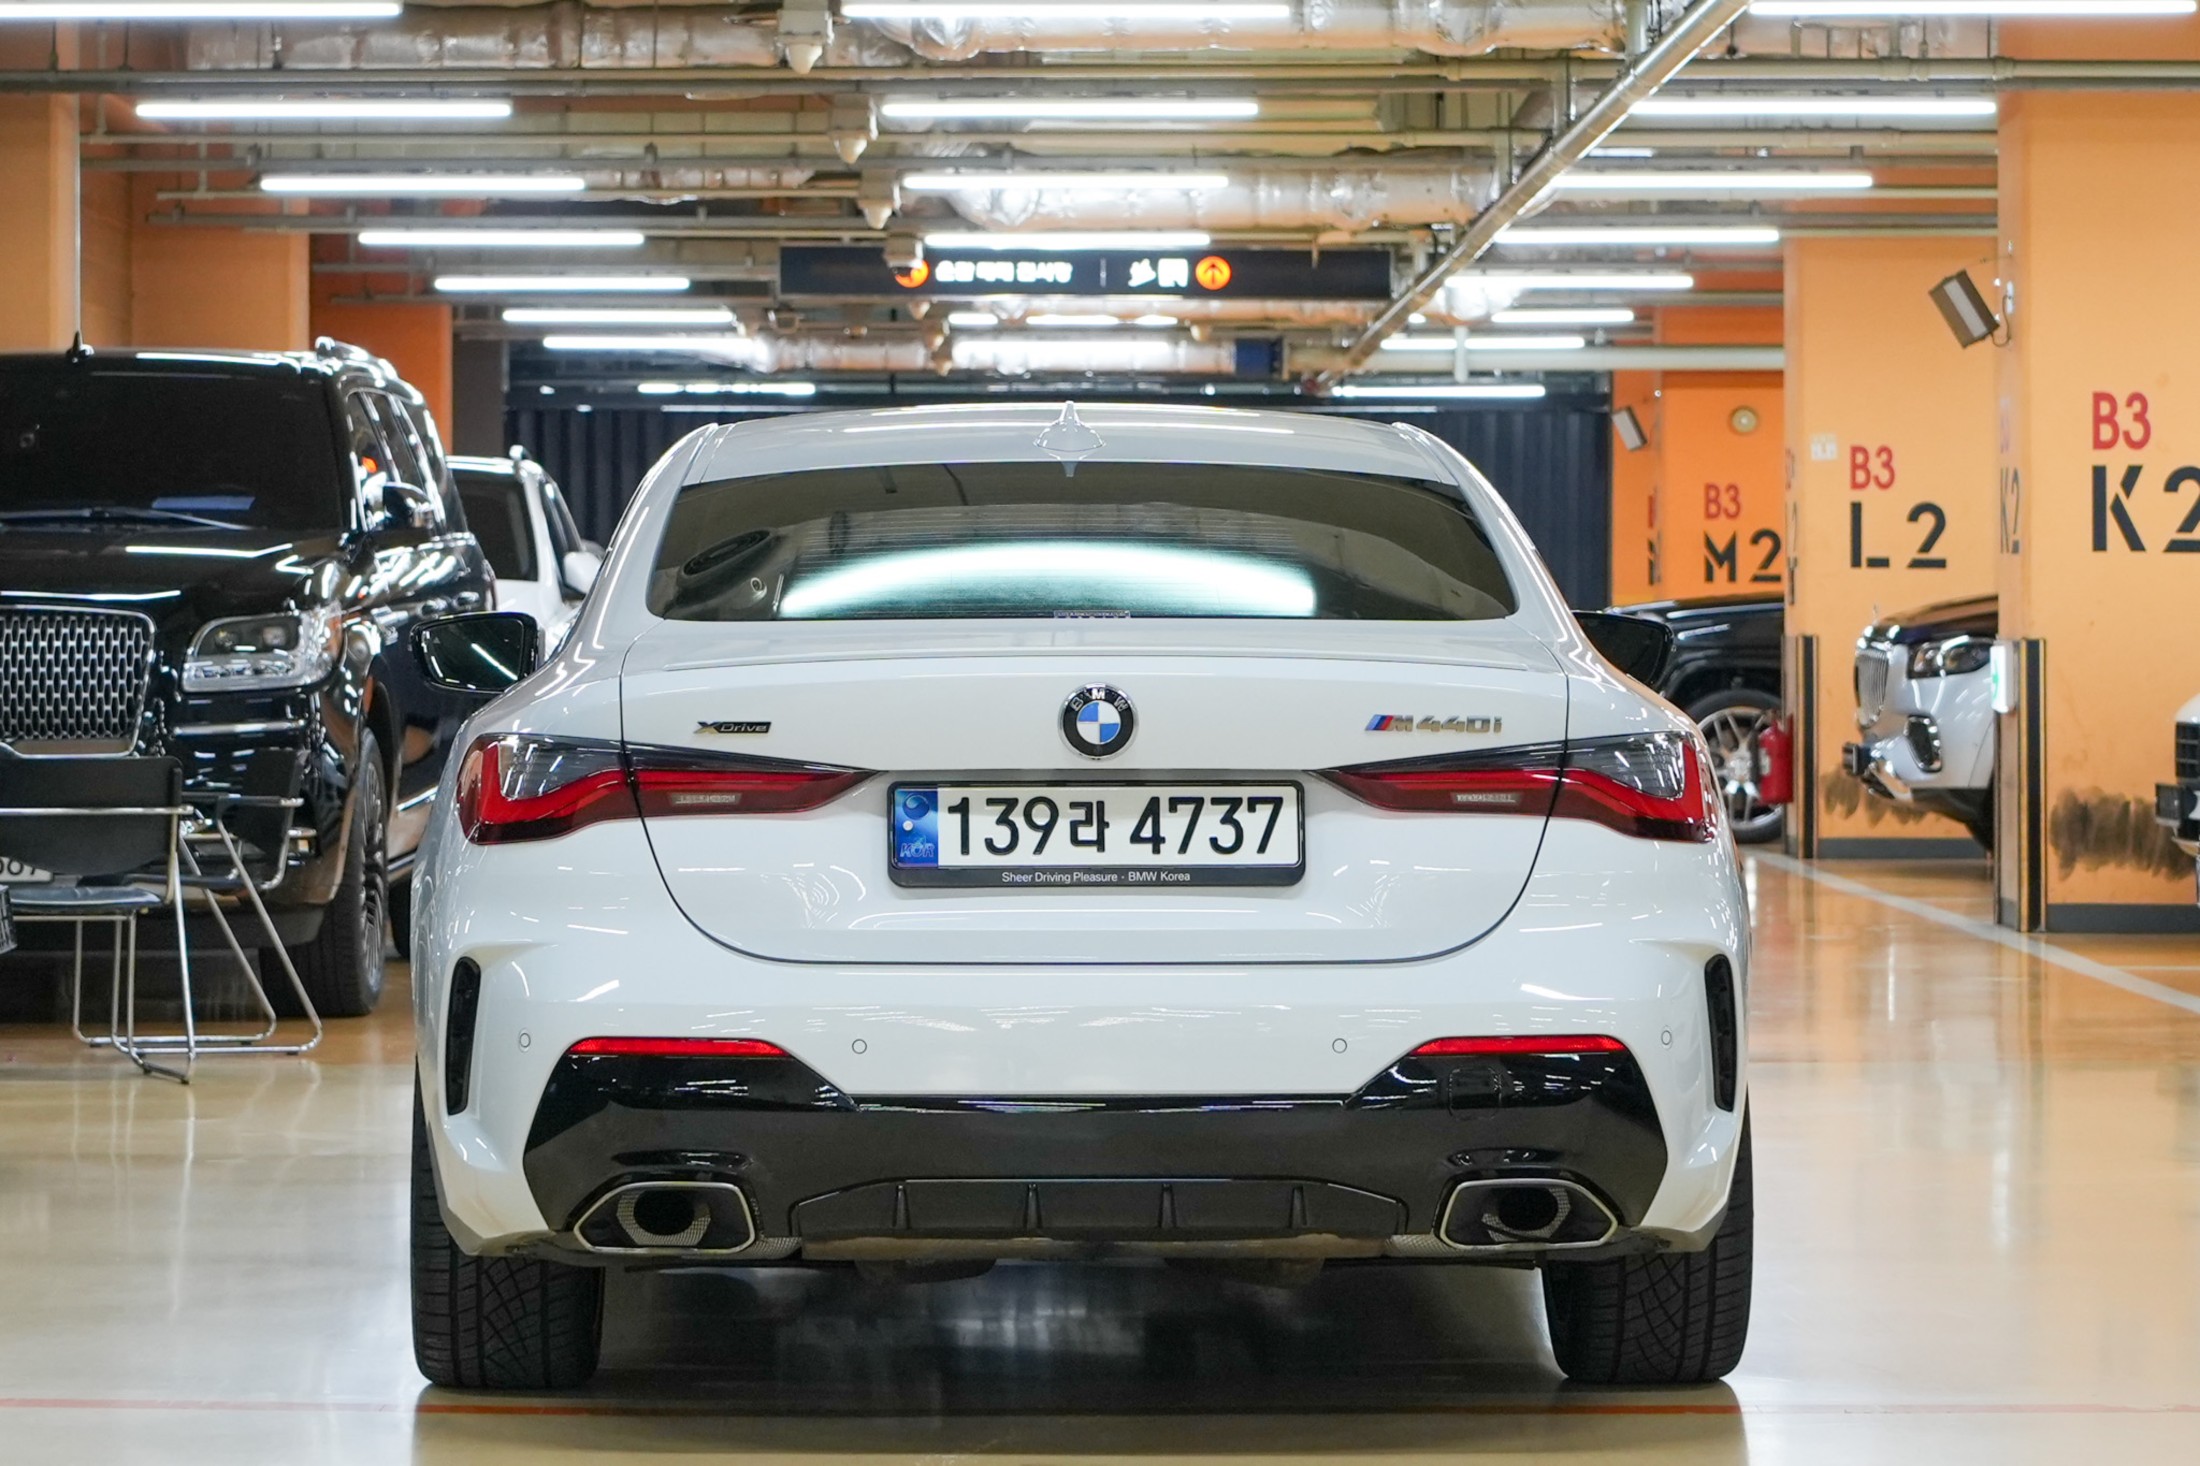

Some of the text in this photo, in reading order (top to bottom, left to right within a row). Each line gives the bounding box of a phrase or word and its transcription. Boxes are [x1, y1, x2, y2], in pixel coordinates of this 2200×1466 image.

[2092, 391, 2152, 450] B3
[1850, 445, 1896, 490] B3
[1704, 483, 1741, 519] B3
[1704, 528, 1782, 583] M2
[1070, 687, 1129, 712] BMW
[1386, 714, 1503, 734] M440i
[947, 795, 1284, 856] 139라 4737
[900, 842, 935, 858] KOR
[1001, 871, 1191, 884] Sheer Driving Pleasure BMW Korea
